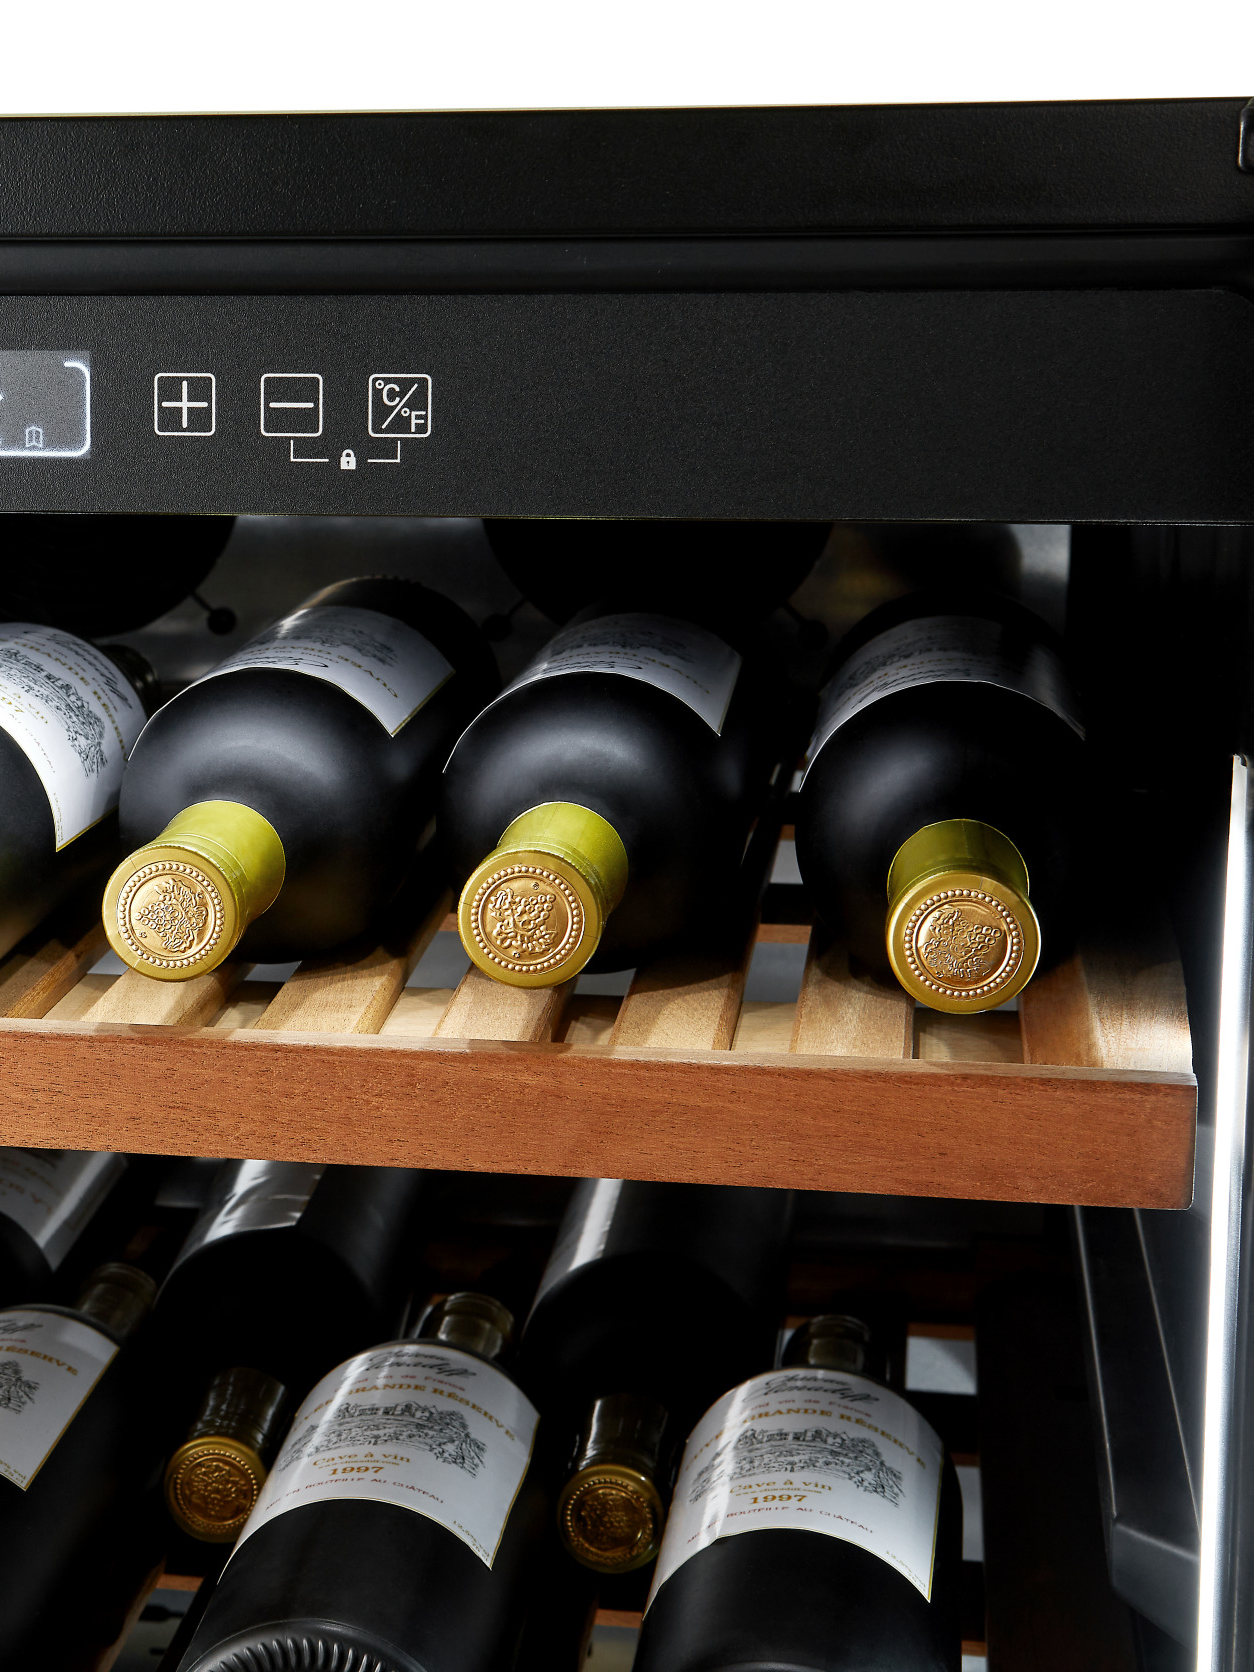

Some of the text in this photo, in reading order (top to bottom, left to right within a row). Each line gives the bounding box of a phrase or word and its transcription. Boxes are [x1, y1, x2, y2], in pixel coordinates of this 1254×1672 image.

[92, 689, 130, 762] RÉSERV
[424, 1375, 466, 1391] France
[430, 1386, 516, 1441] RÉSERVE
[828, 1400, 872, 1418] France
[743, 1407, 833, 1424] GRANDE
[838, 1412, 927, 1470] RÉSERVE
[312, 1451, 411, 1467] Cave à vin
[328, 1465, 385, 1476] 1997
[729, 1478, 833, 1494] Cave à vin
[750, 1493, 807, 1505] 1997
